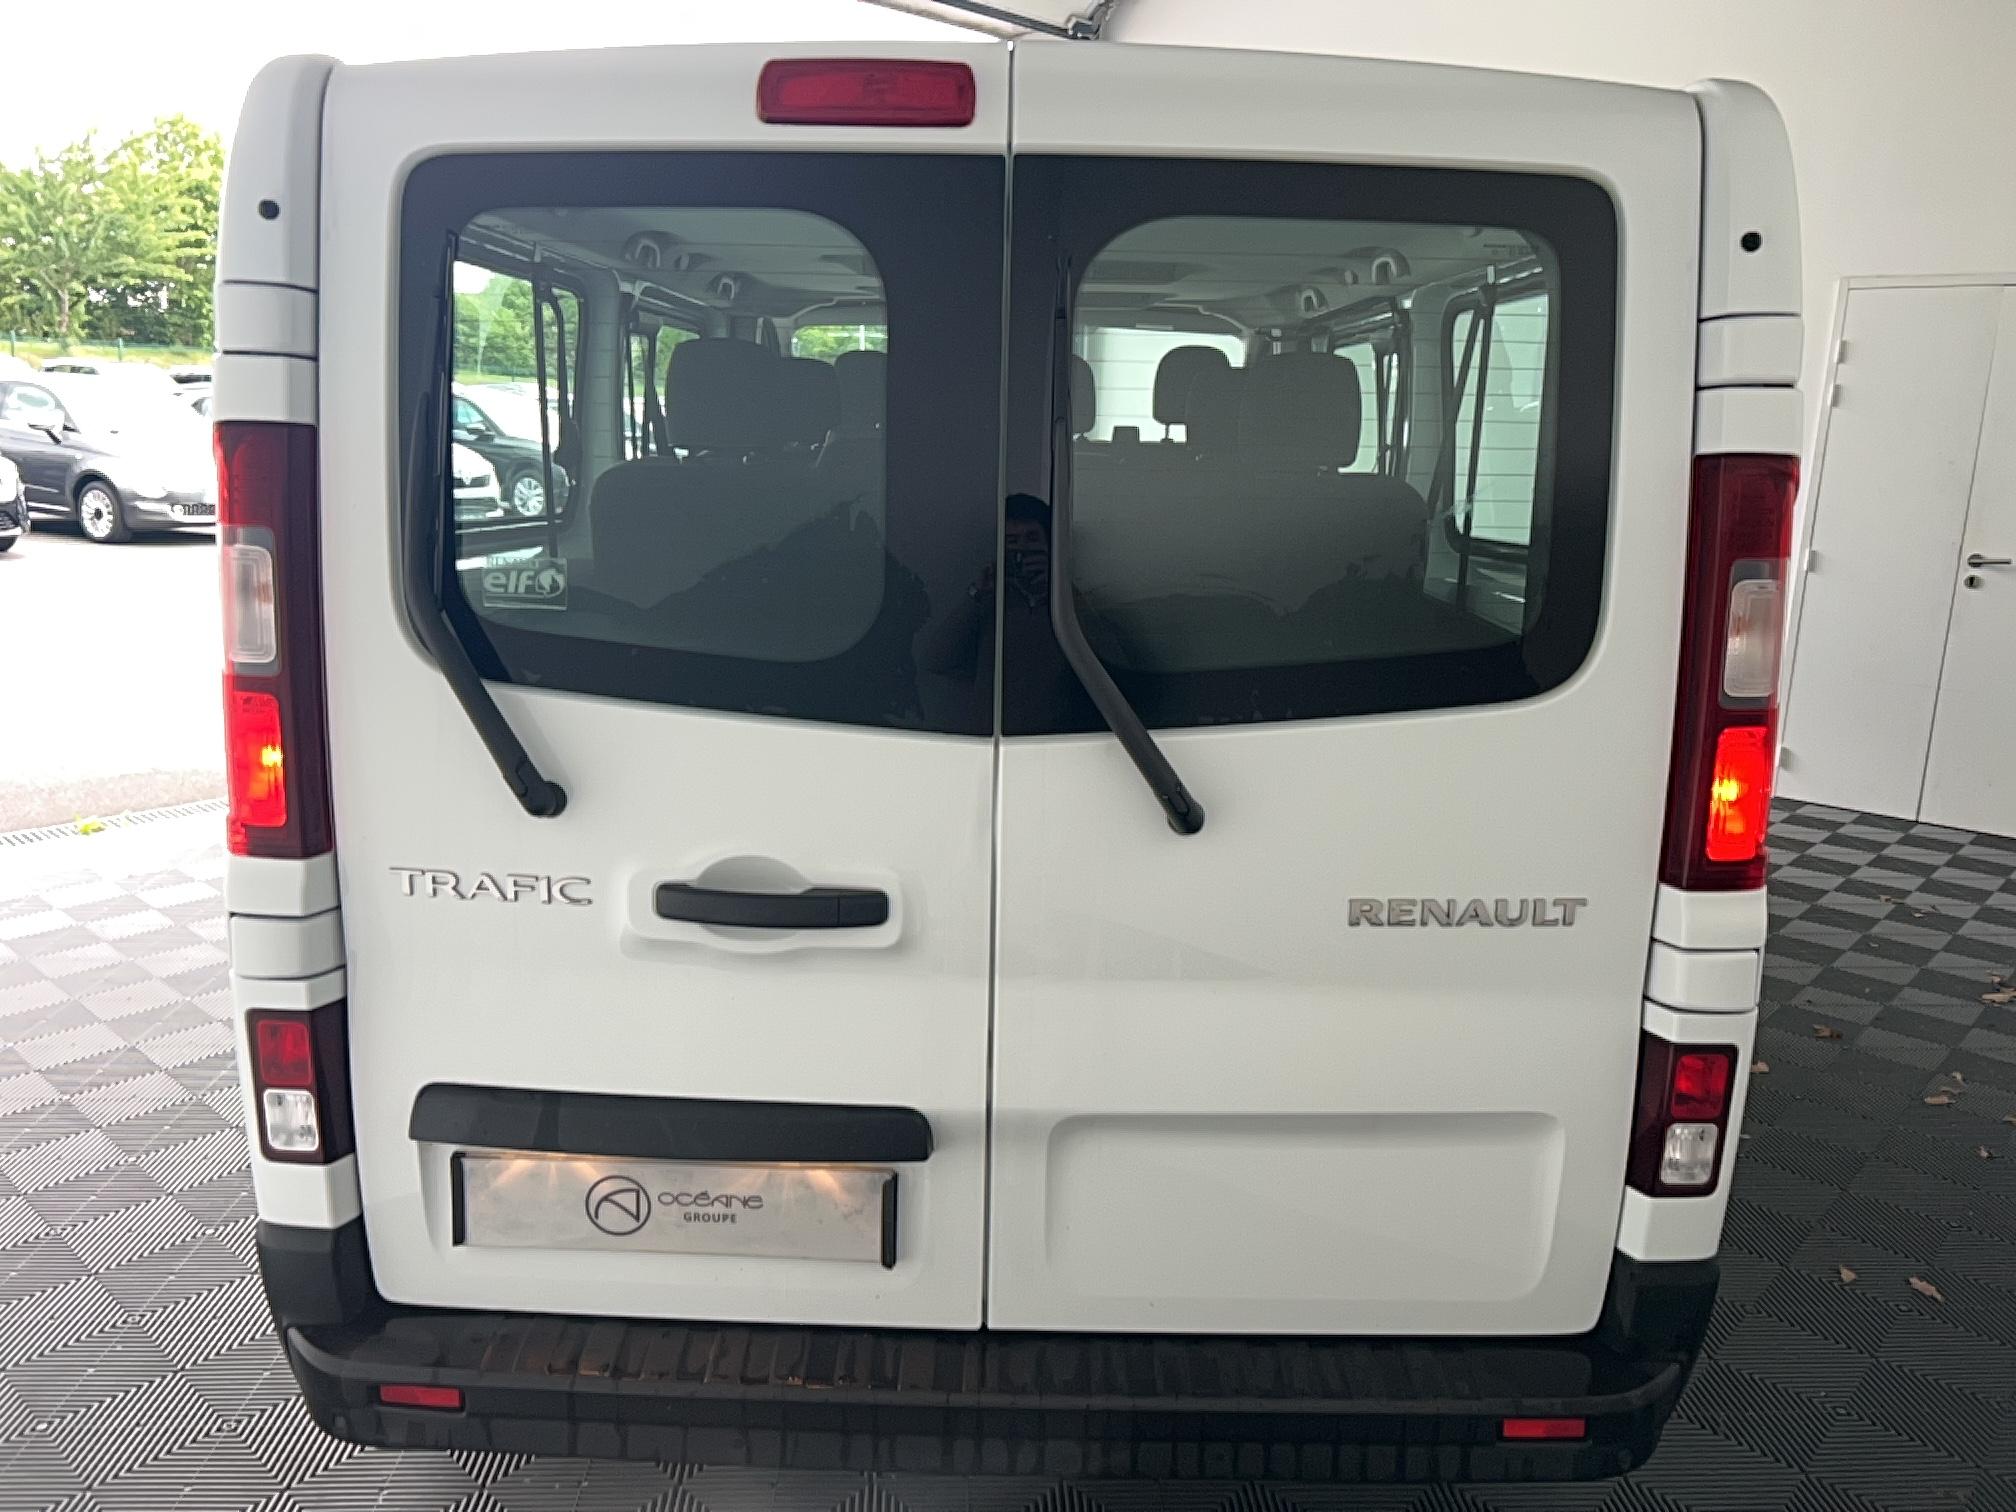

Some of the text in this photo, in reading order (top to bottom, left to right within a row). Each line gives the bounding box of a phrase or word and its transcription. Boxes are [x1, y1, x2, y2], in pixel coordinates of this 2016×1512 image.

[483, 569, 535, 593] elf
[389, 866, 593, 905] TRAFIC
[1348, 898, 1588, 927] RENAULT
[683, 1212, 738, 1223] GROUPE
